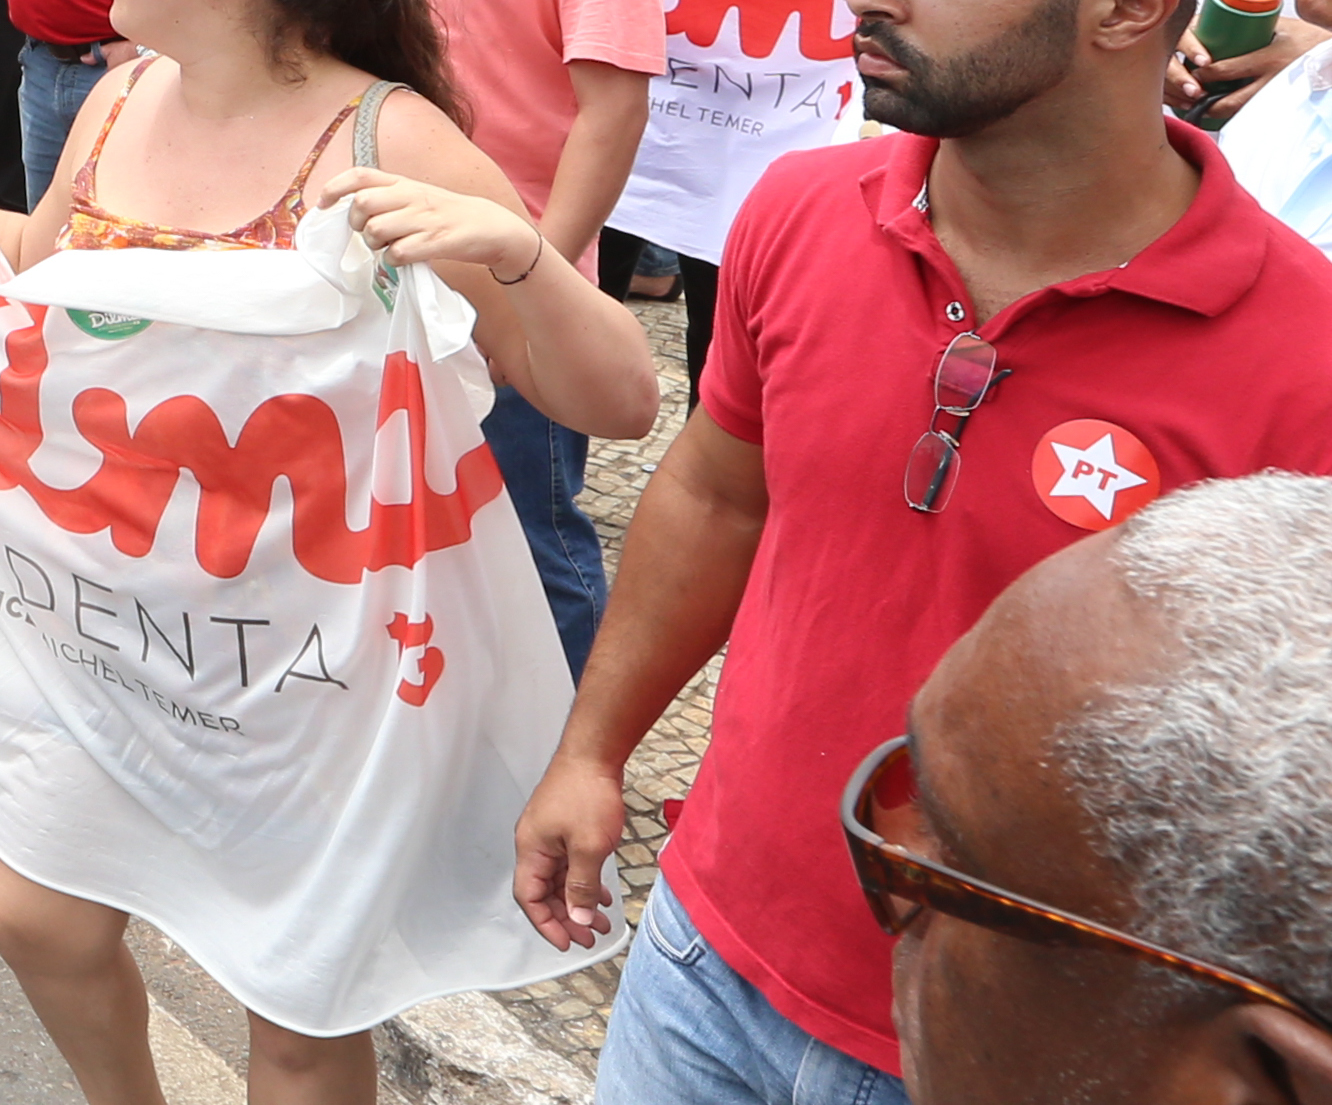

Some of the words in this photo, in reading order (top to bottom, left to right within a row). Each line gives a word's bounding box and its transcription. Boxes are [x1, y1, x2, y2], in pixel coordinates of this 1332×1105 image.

[697, 106, 765, 137] TEMER
[1071, 458, 1120, 492] PT
[135, 678, 246, 737] TEMER
